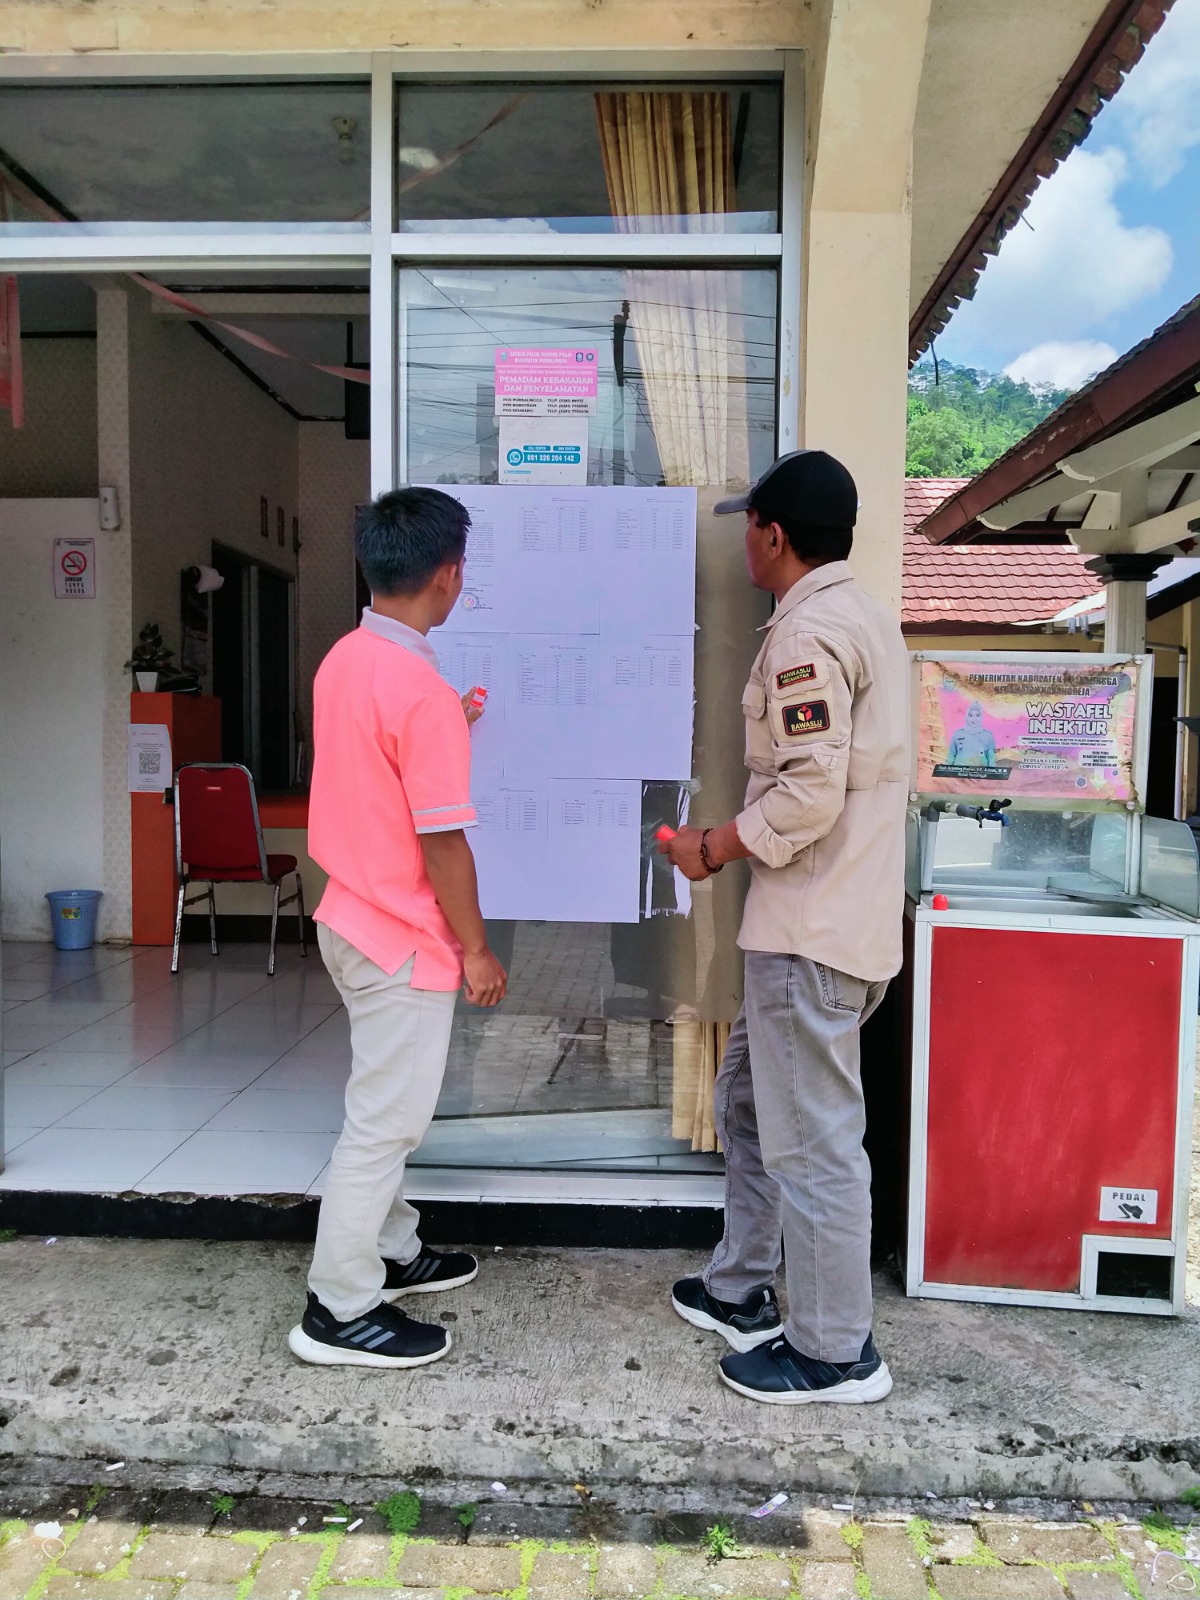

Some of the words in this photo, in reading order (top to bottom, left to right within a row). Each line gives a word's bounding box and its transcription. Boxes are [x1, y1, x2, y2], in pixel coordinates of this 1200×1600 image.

[780, 667, 811, 679] PANWASLU
[969, 674, 1016, 682] PEMERINTAH
[1018, 674, 1062, 683] KABUPATEN
[1026, 702, 1112, 719] WASTAFEL
[791, 719, 822, 732] BAWASLU
[1029, 719, 1107, 736] INJEKTUR
[1113, 1192, 1146, 1201] PEDAL
